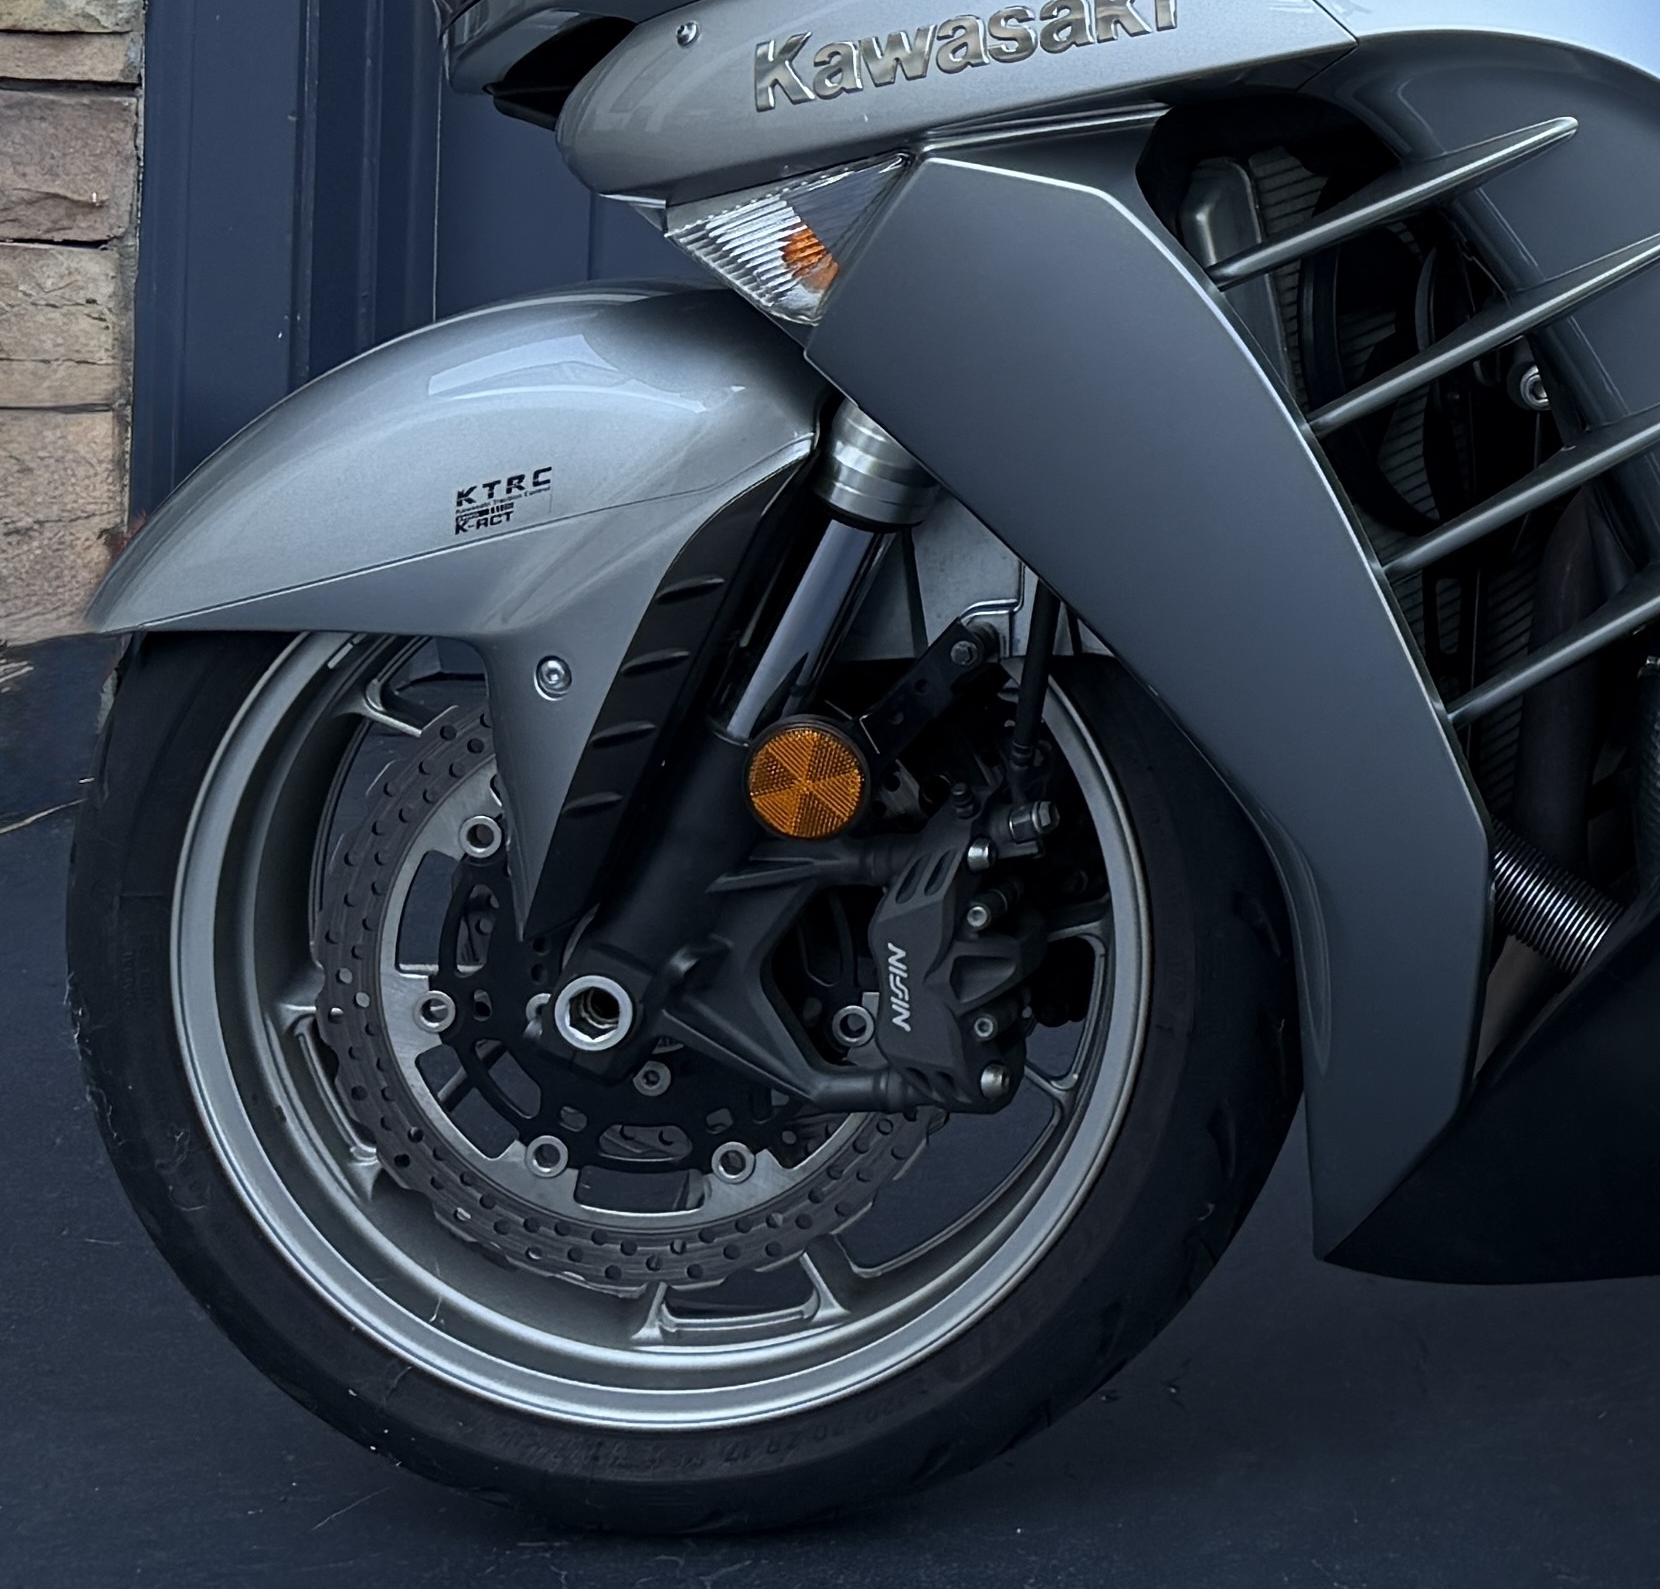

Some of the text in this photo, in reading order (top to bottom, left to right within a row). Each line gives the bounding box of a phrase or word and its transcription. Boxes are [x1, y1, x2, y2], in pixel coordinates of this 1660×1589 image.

[456, 466, 553, 507] KTRC
[454, 511, 514, 535] K-ACT
[887, 942, 911, 1032] NISSIN
